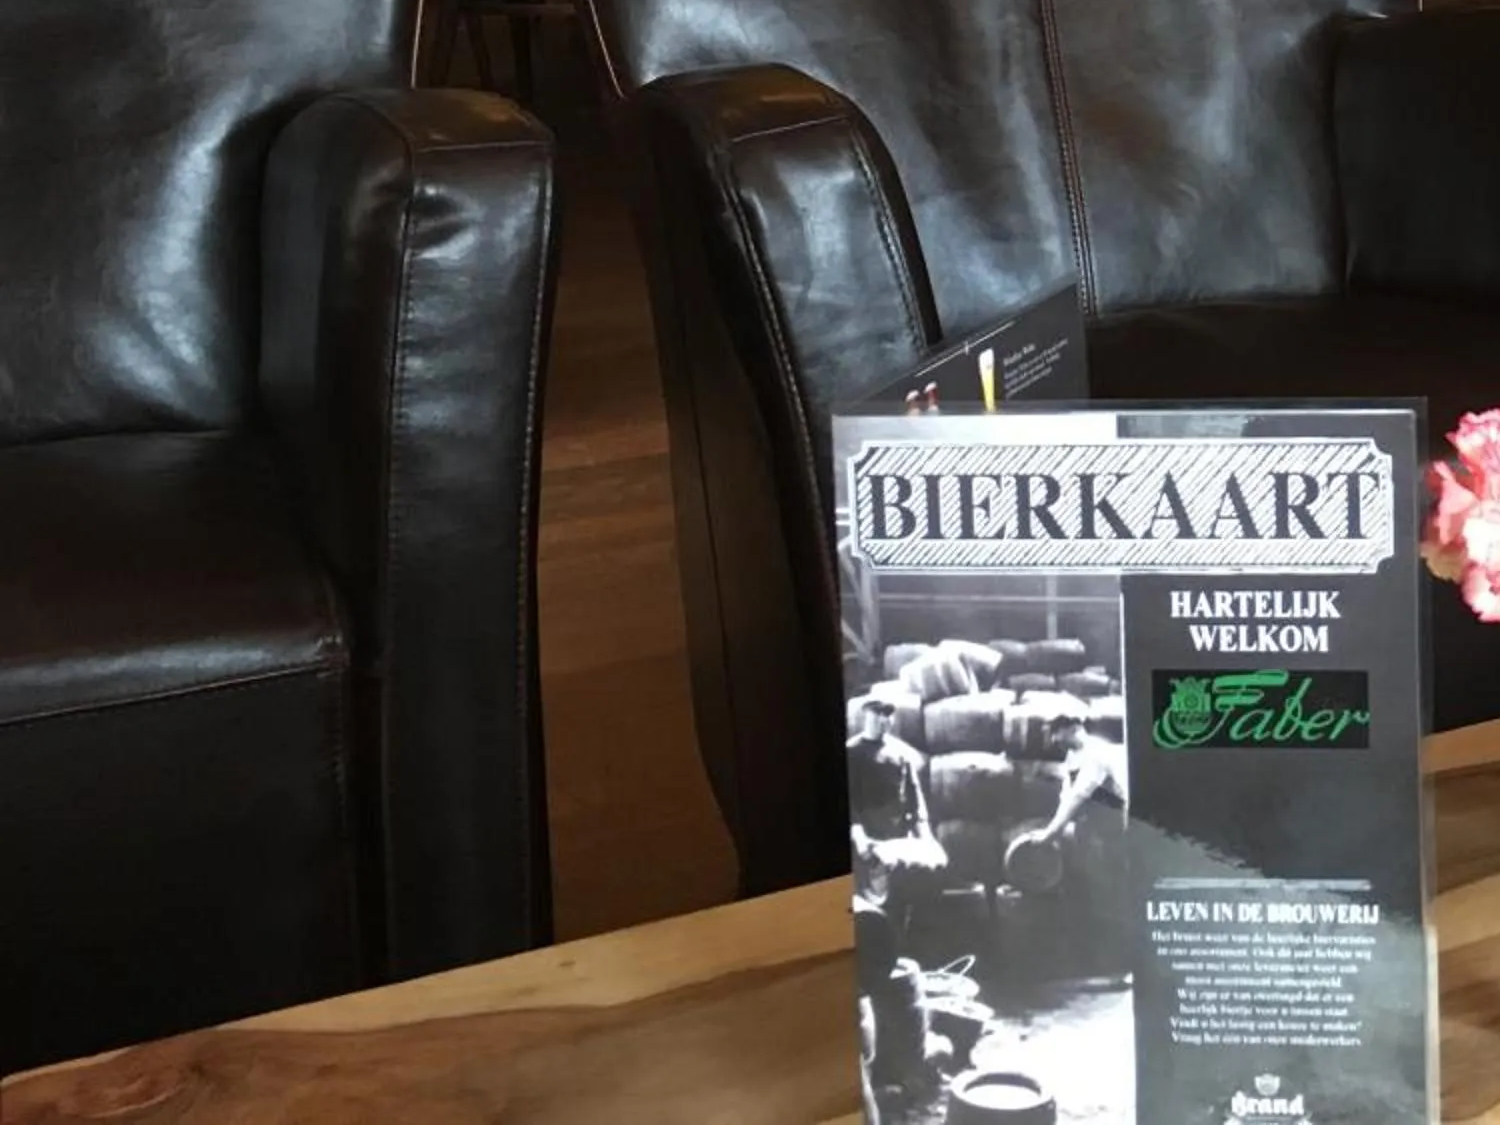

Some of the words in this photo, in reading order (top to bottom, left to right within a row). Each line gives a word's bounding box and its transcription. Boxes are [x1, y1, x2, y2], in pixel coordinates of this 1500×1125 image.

[863, 472, 1379, 540] BIERKAART
[1170, 590, 1341, 619] HARTELIJK
[1189, 624, 1330, 653] WELKOM
[1153, 669, 1370, 749] Faber
[1146, 901, 1208, 922] LEVEN
[1213, 903, 1234, 922] IN
[1238, 903, 1264, 924] DE
[1267, 904, 1380, 925] BROUWERIJ
